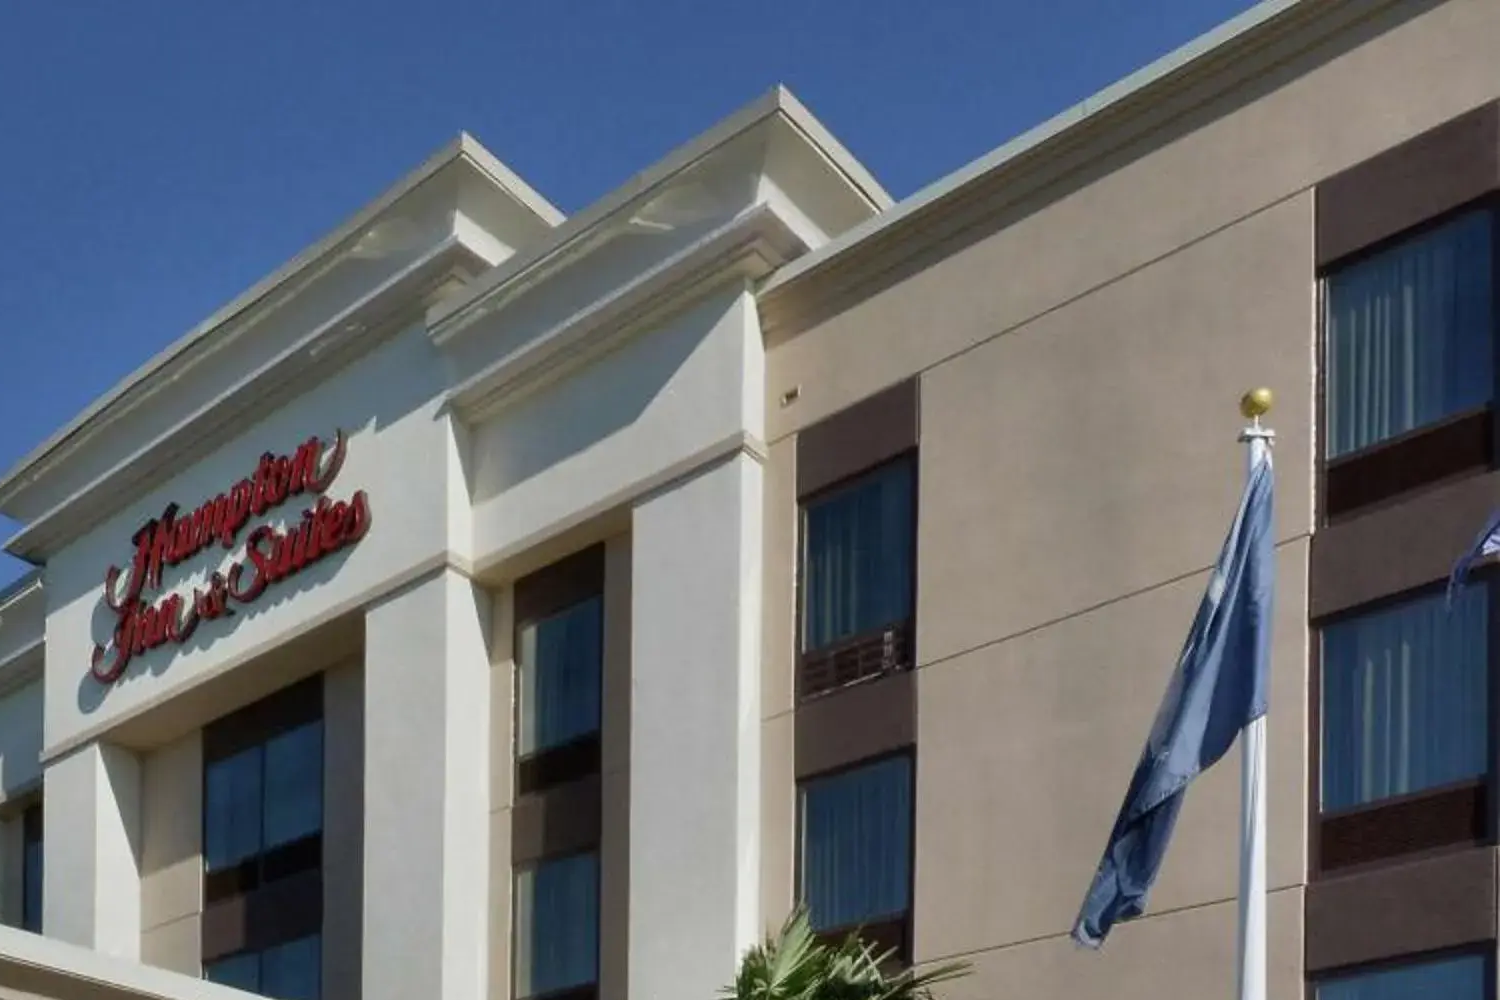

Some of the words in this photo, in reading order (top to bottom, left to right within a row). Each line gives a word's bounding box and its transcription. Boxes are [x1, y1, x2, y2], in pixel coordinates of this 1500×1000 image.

[92, 593, 199, 683] Inn
[196, 571, 235, 620] &
[228, 489, 372, 603] Suites
[105, 428, 348, 613] Hampton
